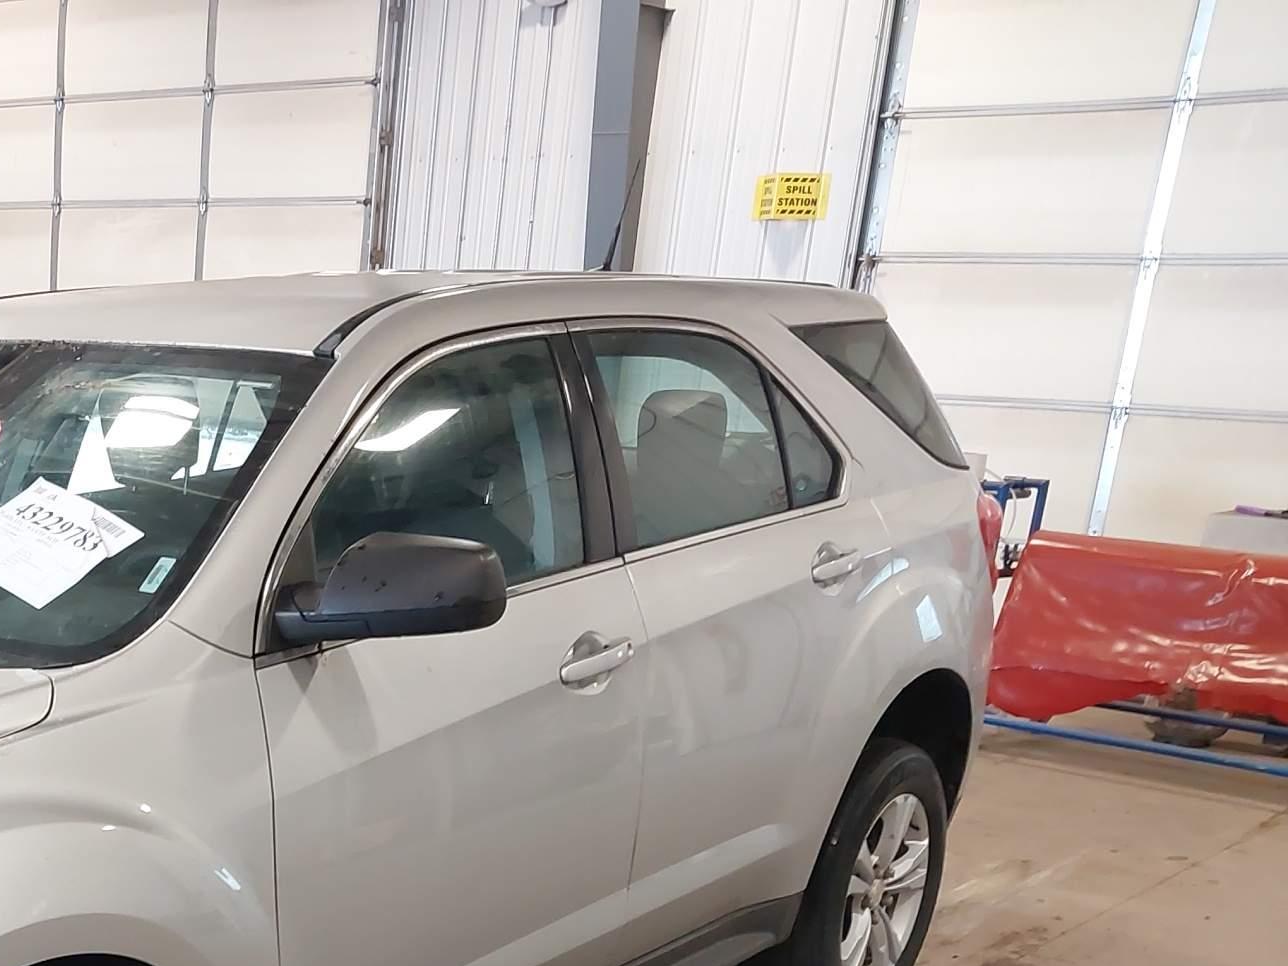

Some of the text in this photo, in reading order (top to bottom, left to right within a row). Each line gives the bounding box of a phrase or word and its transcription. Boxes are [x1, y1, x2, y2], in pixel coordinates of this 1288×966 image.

[786, 185, 813, 195] SPILL
[777, 197, 818, 207] STATION
[16, 503, 103, 551] 43229783
